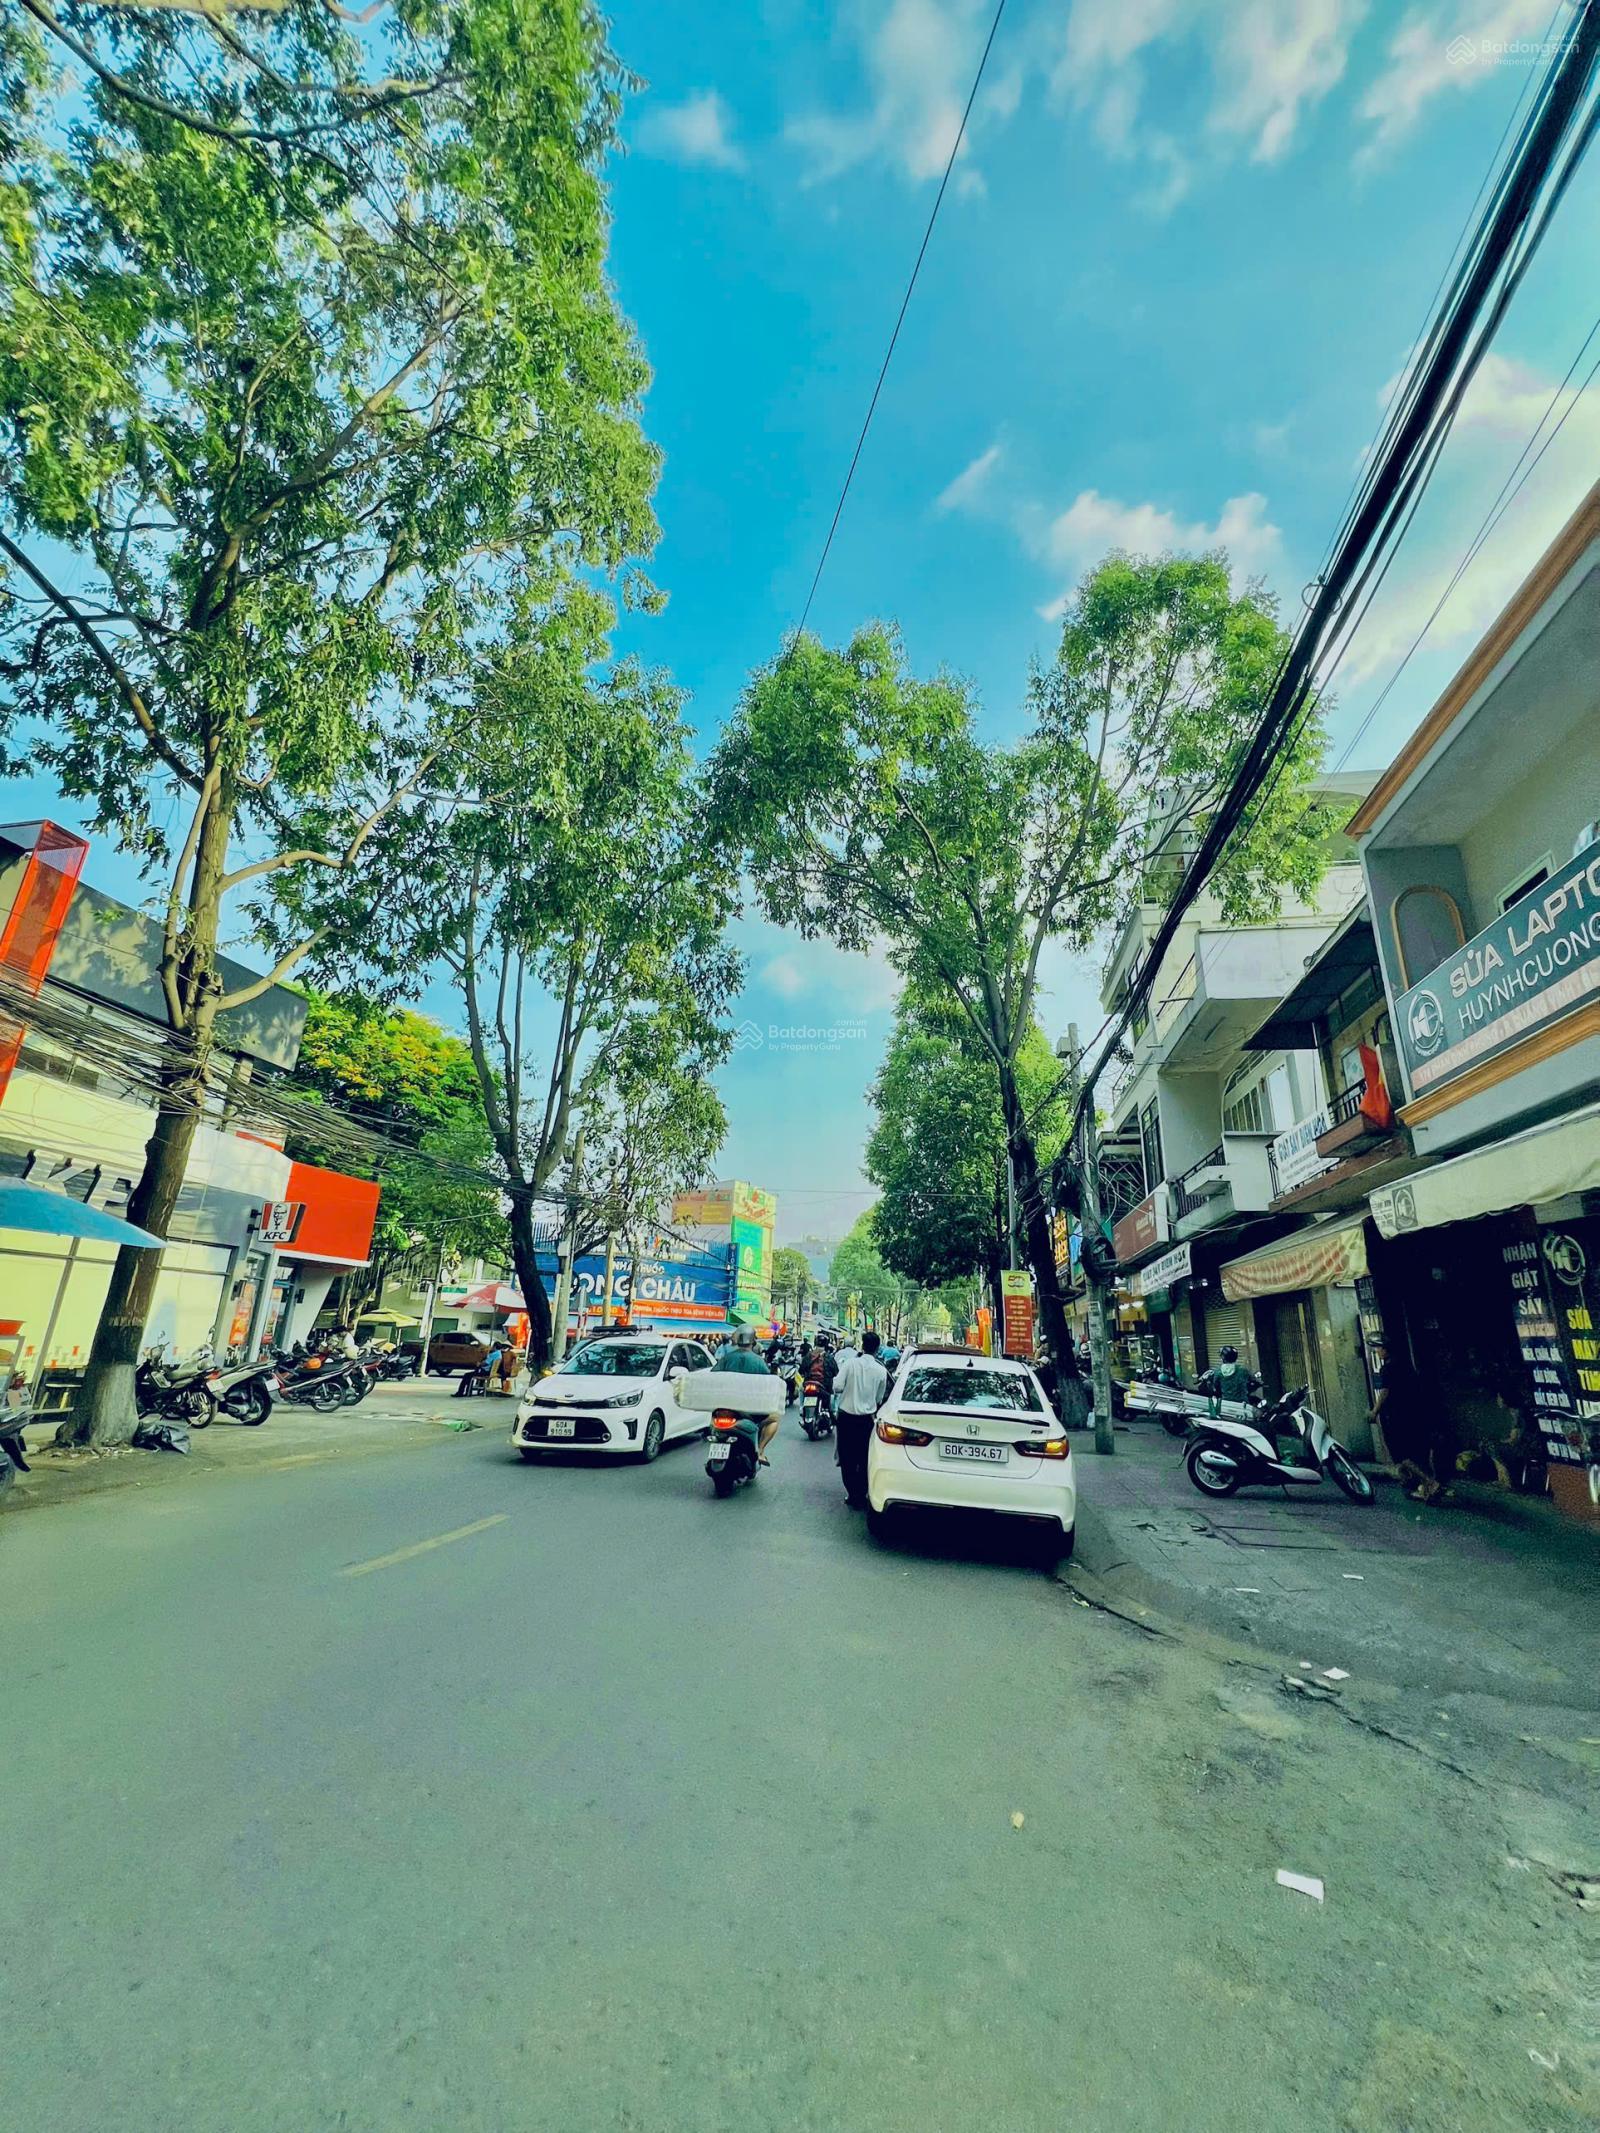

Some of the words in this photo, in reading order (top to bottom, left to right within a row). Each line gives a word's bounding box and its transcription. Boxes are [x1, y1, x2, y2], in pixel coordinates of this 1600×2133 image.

[1450, 943, 1504, 998] SỬA
[263, 1231, 287, 1240] KFC
[1502, 1241, 1538, 1264] NHẬN
[641, 1276, 696, 1301] CHÂU
[1511, 1268, 1539, 1291] GIẶT
[1518, 1292, 1544, 1315] SẤY
[1566, 1304, 1593, 1329] SỬA
[945, 1445, 1002, 1460] 60K-394.67
